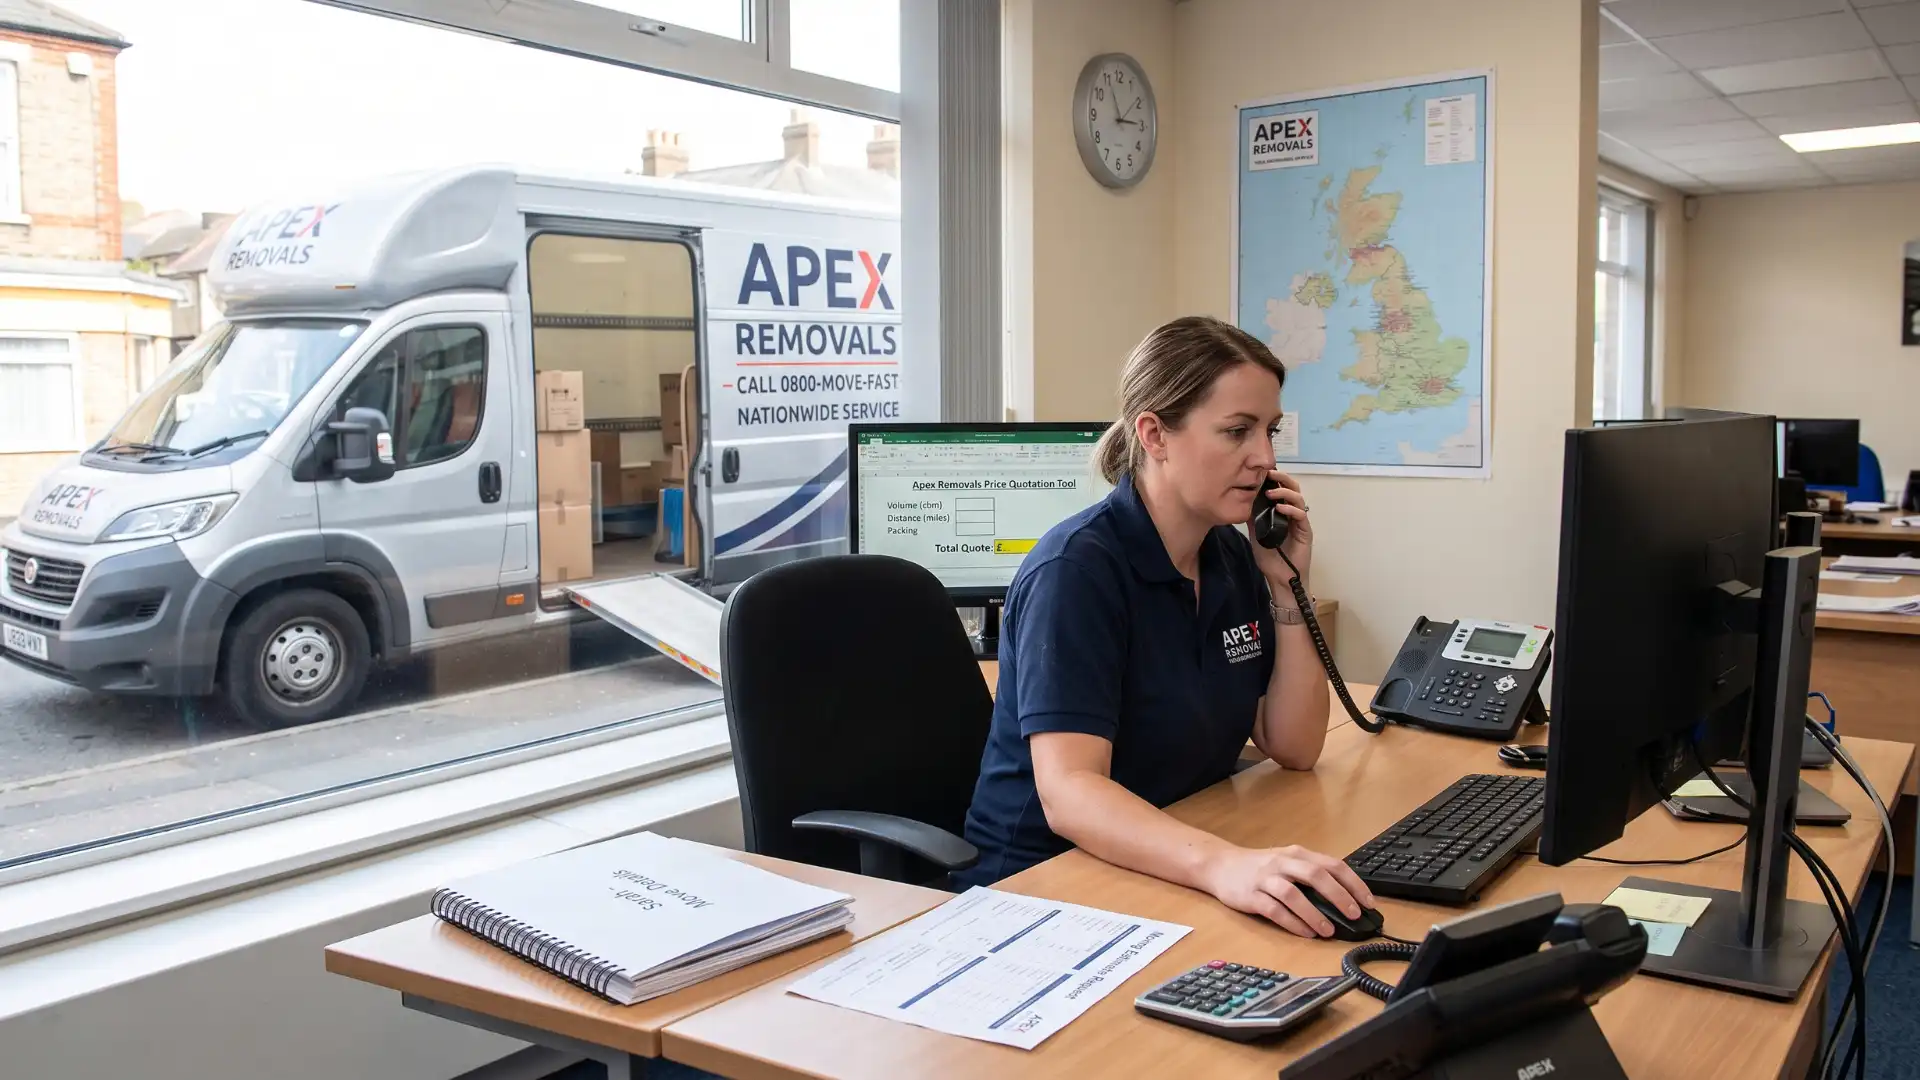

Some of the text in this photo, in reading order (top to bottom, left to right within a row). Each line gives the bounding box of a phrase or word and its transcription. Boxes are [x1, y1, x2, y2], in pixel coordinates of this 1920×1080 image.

[1103, 72, 1112, 86] 11
[1114, 69, 1124, 84] 12
[1095, 87, 1104, 101] 10
[1136, 96, 1142, 109] 2
[1090, 108, 1097, 121] 9
[1139, 120, 1145, 132] 3
[1253, 117, 1313, 142] APEX
[1094, 130, 1101, 144] 8
[1253, 139, 1313, 155] REMOVALS
[1104, 148, 1110, 161] 7
[1127, 154, 1133, 167] 5
[1115, 158, 1121, 171] 6
[236, 203, 341, 247] APEX
[225, 244, 314, 272] REMOVALS
[737, 243, 895, 310] APEX
[736, 322, 897, 356] REMOVALS
[736, 373, 899, 394] CALL 0800-MOVE-FAST
[738, 401, 900, 426] NATIONWIDE SERVICE
[912, 478, 1076, 491] Apex Removals Price Quotation Tool
[41, 483, 105, 511] APEX
[887, 501, 943, 510] Volume (cbm)
[887, 514, 950, 523] Distance (miles)
[887, 527, 918, 536] Packing
[935, 543, 960, 553] Total
[961, 543, 994, 554] Quote:
[1222, 620, 1261, 647] APEX
[612, 869, 715, 909] Move Details
[614, 889, 663, 911] Sarah
[1517, 1057, 1556, 1080] APEX
